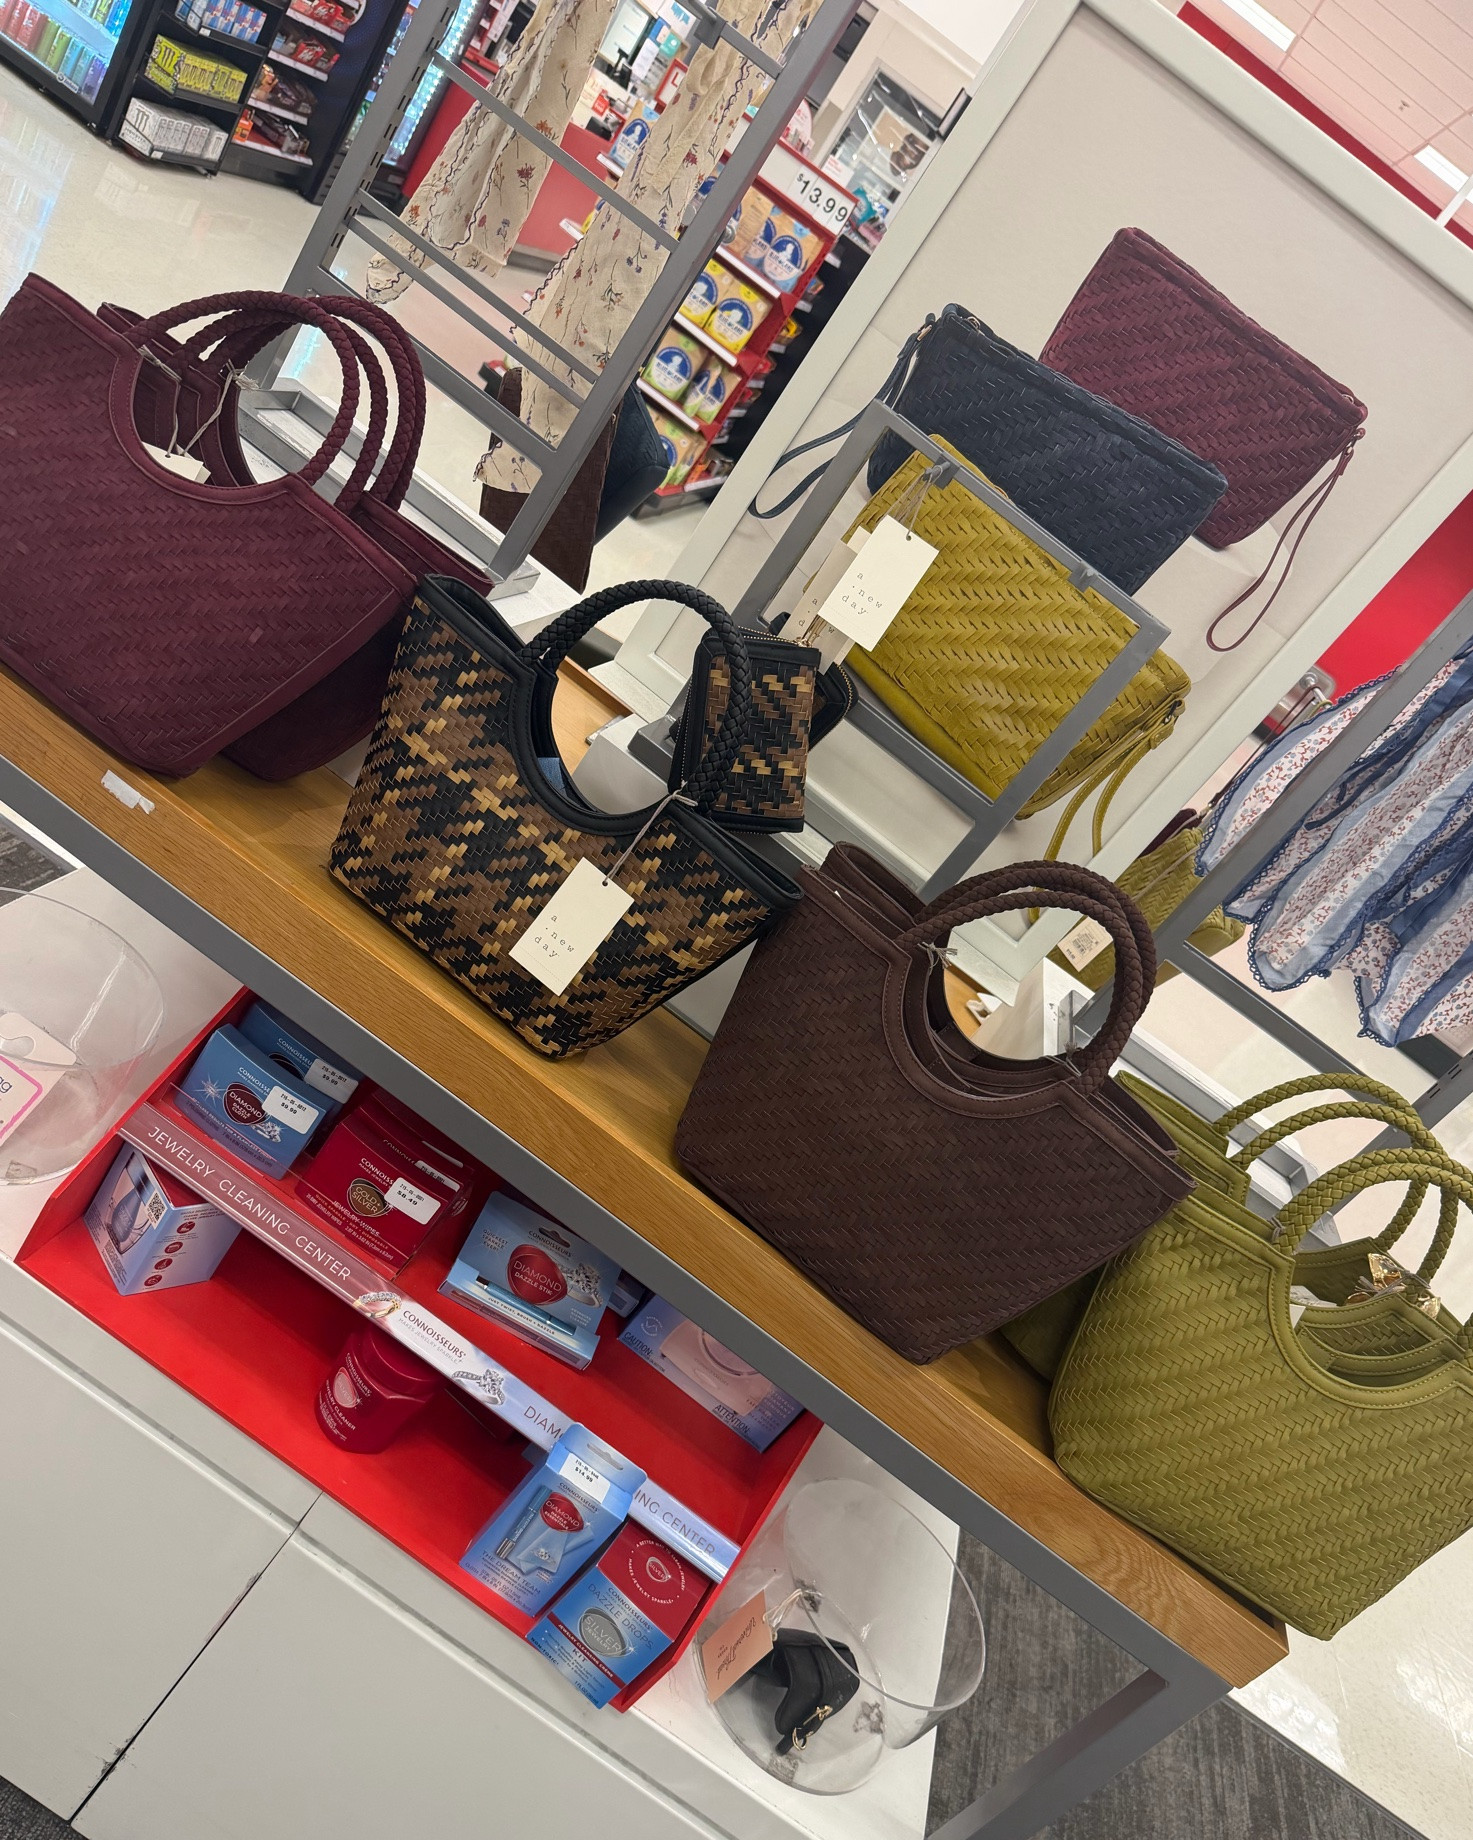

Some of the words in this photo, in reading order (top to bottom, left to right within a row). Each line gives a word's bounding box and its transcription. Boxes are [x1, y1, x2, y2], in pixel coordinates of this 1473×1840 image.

[795, 172, 849, 223] $13.99
[856, 571, 864, 580] a
[840, 593, 867, 615] day
[857, 588, 882, 609] new
[549, 913, 559, 923] a
[533, 934, 559, 958] day
[550, 930, 575, 953] new
[277, 1037, 312, 1065] CONNOISSEU
[237, 1066, 272, 1093] CONNOISSE
[228, 1090, 263, 1118] DIAMOND
[230, 1105, 247, 1119] CLOTH
[280, 1101, 297, 1114] $9.99
[359, 1157, 395, 1185] CONNOISS
[146, 1124, 215, 1180] JEWELRY
[216, 1177, 291, 1236] CLEANING
[292, 1232, 352, 1282] CENTER
[350, 1191, 378, 1213] SILVER
[396, 1189, 418, 1205] $8.49
[331, 1200, 360, 1224] JEWELRY
[359, 1220, 380, 1237] WIPES
[480, 1233, 504, 1250] SPARKLE
[482, 1228, 508, 1245] QUICKEST
[527, 1229, 572, 1258] CONNOISSEURS
[512, 1259, 562, 1293] DIAMOND
[513, 1271, 539, 1288] DAZZLE
[538, 1284, 552, 1296] STIK
[487, 1296, 499, 1305] JUST
[516, 1312, 532, 1323] BRUSH
[536, 1323, 555, 1335] DAZZLE
[402, 1309, 465, 1359] CONNOISSEURS
[623, 1330, 654, 1357] CAUTION:
[334, 1405, 356, 1430] CLEANER
[522, 1404, 564, 1441] DIAM
[714, 1402, 751, 1435] ATTENTION:
[573, 1466, 593, 1483] $14.99
[557, 1481, 599, 1513] CONNOISSEURS
[544, 1499, 580, 1527] DIAMOND
[549, 1511, 567, 1525] DAZZLE
[660, 1509, 717, 1557] CENTER
[481, 1550, 495, 1562] THE
[495, 1560, 520, 1580] DREAM
[520, 1579, 541, 1594] TEAM
[587, 1582, 622, 1619] DAZZLE
[620, 1616, 653, 1648] DROPS
[607, 1586, 652, 1630] CONNOISSEURS
[557, 1623, 577, 1642] JEWELRY
[576, 1640, 599, 1664] CLEANSING
[582, 1614, 622, 1652] SILVER
[583, 1625, 611, 1651] JEWELRY
[571, 1648, 588, 1663] KIT
